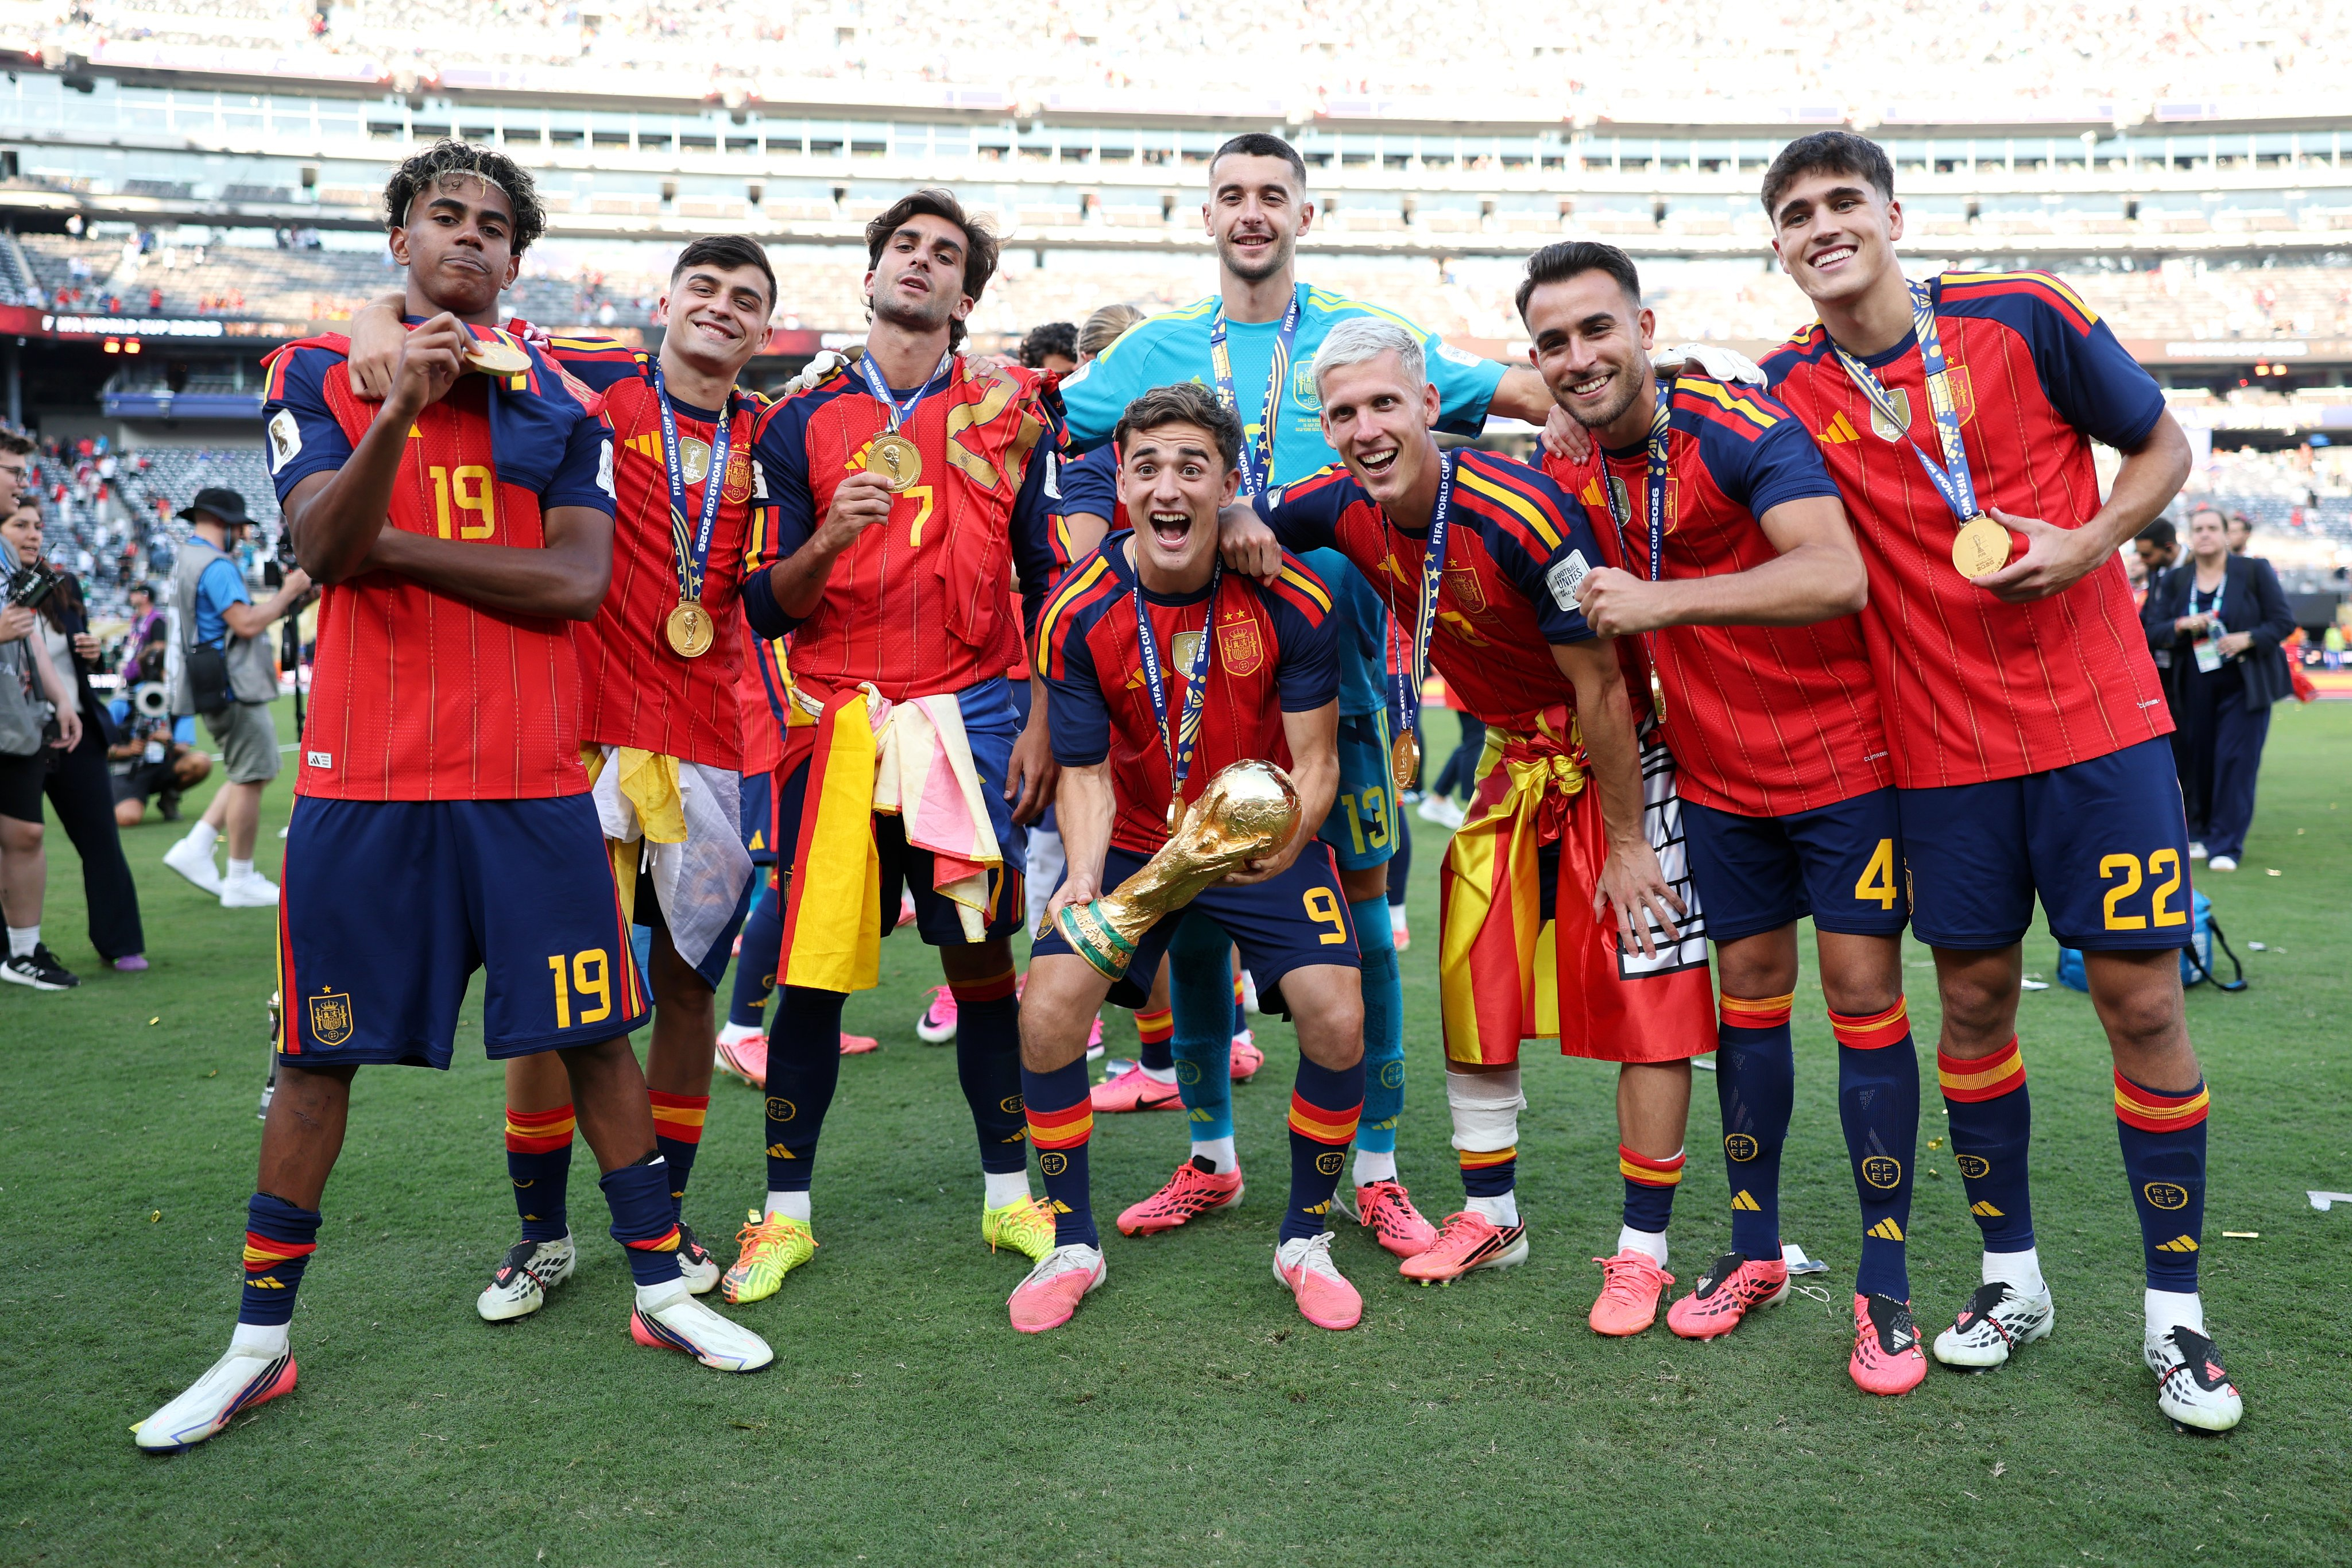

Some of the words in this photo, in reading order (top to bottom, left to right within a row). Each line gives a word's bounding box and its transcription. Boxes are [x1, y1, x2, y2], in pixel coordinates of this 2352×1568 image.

[1283, 315, 1295, 332] FIFA
[864, 359, 873, 372] FIFA
[868, 370, 881, 386] WORLD
[664, 416, 673, 436] CUP
[667, 439, 678, 477] WORLD
[715, 440, 726, 458] FIFA
[1239, 451, 1253, 486] WORLD
[1441, 459, 1450, 480] CUP
[1921, 455, 1937, 474] FIFA
[672, 477, 681, 495] FIFA
[709, 458, 723, 496] WORLD
[1955, 472, 1968, 496] FIFA
[430, 466, 494, 539] 19
[703, 496, 716, 518] CUP
[1436, 482, 1449, 520] WORLD
[1651, 487, 1659, 526] 2026
[903, 485, 933, 547] 7
[698, 518, 711, 552] 2026
[1432, 522, 1444, 545] FIFA
[1554, 562, 1579, 581] FOOTBALL
[1557, 568, 1583, 589] UNITES
[1560, 589, 1572, 597] the
[1139, 625, 1151, 644] CUP
[1197, 626, 1208, 663] 2026
[1144, 648, 1159, 684] WORLD
[1152, 686, 1163, 707] FIFA
[1341, 786, 1389, 854] 13
[1855, 838, 1897, 910] 4
[2099, 848, 2187, 930] 22
[1303, 886, 1347, 945] 9
[1083, 928, 1103, 950] CUP
[548, 948, 611, 1028] 19
[1730, 1140, 1748, 1148] RF
[1731, 1148, 1749, 1156] EF
[1871, 1163, 1893, 1172] RF
[1960, 1159, 1978, 1167] RF
[1962, 1166, 1980, 1174] EF
[1872, 1172, 1893, 1182] EF
[2153, 1187, 2176, 1196] RF
[2155, 1195, 2177, 1204] EF
